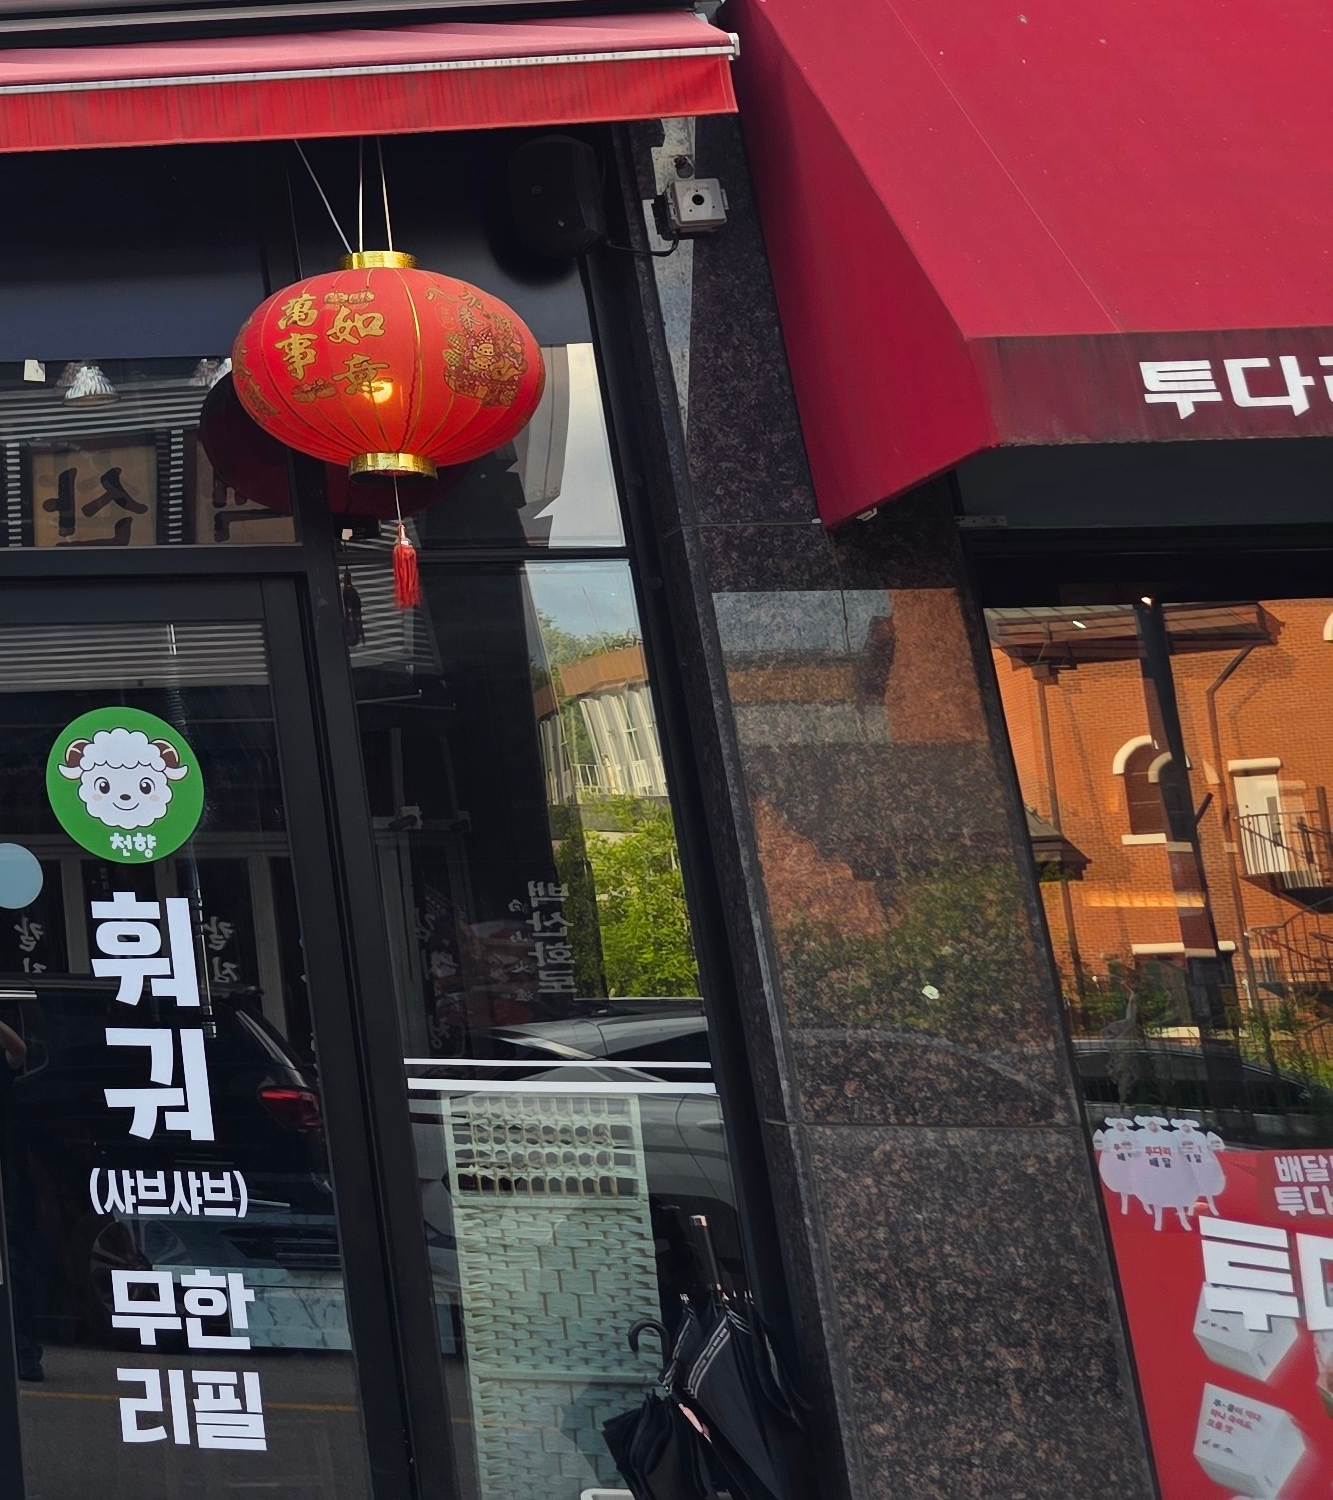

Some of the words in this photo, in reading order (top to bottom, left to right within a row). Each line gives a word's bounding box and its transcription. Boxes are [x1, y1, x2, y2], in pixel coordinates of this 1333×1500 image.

[110, 832, 156, 858] 천향
[90, 891, 215, 1141] 훠궈
[90, 1167, 248, 1218] (샤브샤브)
[111, 1269, 256, 1350] 무한
[116, 1367, 268, 1451] 리필
